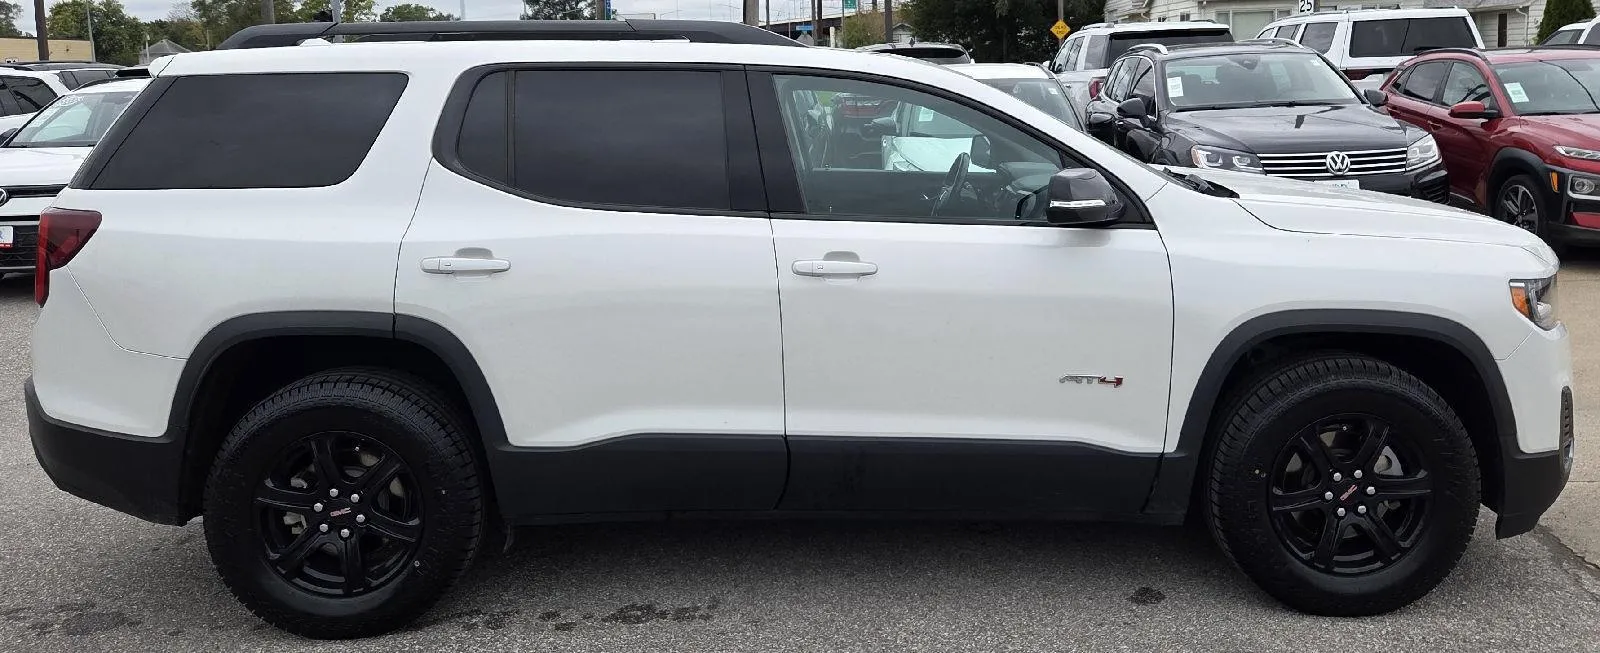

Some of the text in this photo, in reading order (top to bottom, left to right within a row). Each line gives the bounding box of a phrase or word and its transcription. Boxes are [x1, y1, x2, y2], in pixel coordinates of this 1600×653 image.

[1300, 0, 1312, 12] 25
[1059, 375, 1123, 388] AT4
[330, 507, 351, 517] GMC
